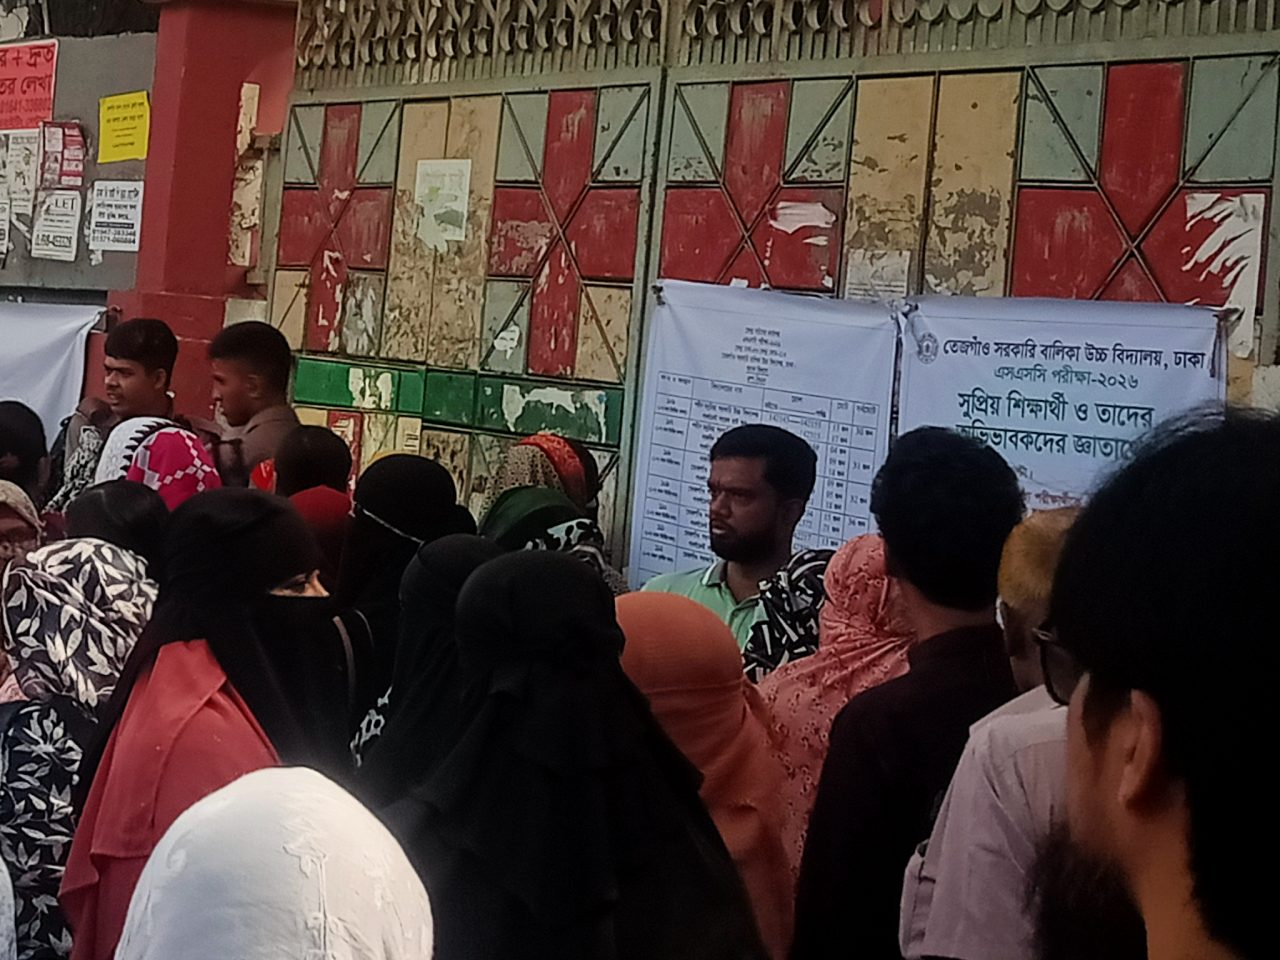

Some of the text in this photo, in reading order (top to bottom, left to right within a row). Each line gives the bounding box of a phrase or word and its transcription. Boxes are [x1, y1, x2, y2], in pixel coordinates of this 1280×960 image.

[26, 44, 55, 68] দ্রুত
[21, 74, 54, 96] লেখা
[943, 336, 991, 357] তেজগাঁও
[994, 338, 1036, 359] সরকারি
[1040, 340, 1081, 362] বালিকা
[1085, 342, 1109, 363] উচ্চ
[1173, 350, 1207, 369] ঢাকা
[994, 363, 1139, 390] এসএসসি পরীক্ষা-২০২৬
[958, 387, 1155, 428] সুপ্রিয় শিক্ষার্থী ও তাদের
